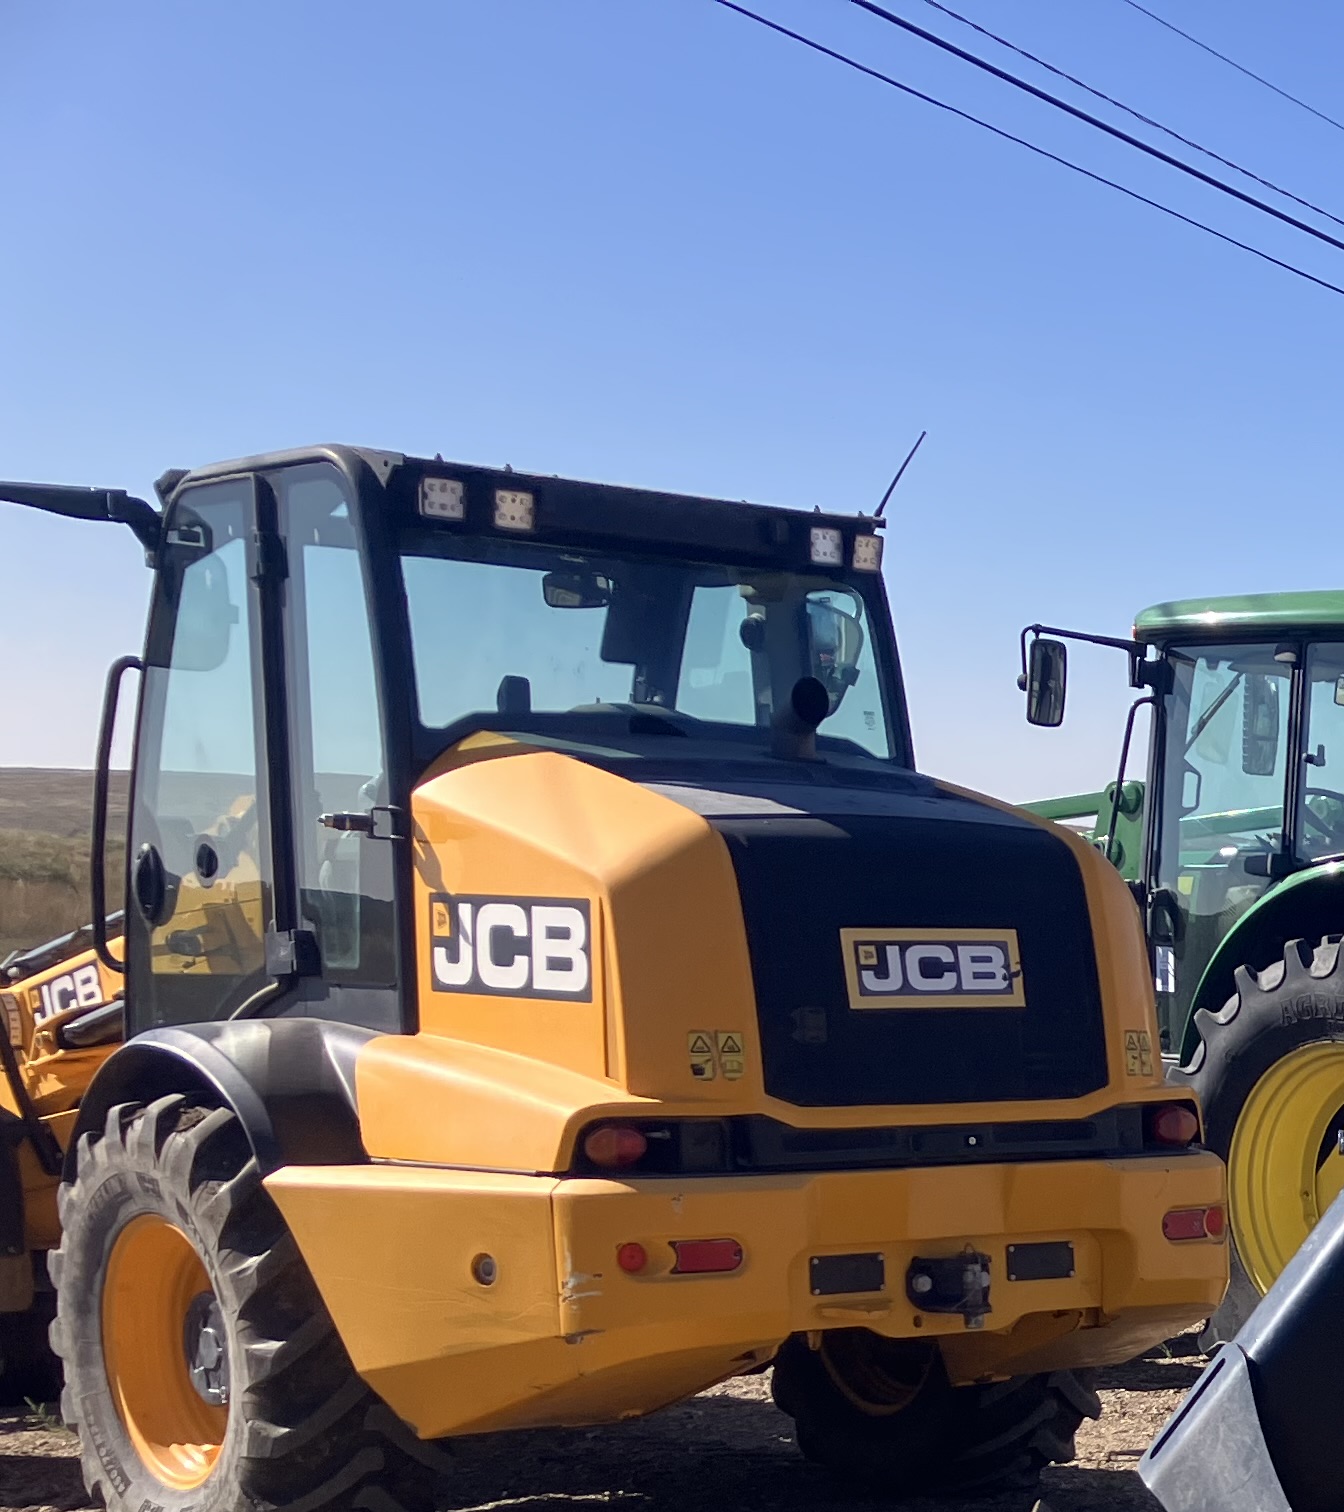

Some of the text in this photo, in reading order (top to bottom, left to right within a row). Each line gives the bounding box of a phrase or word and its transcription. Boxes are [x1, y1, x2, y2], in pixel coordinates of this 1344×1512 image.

[433, 903, 588, 992] JCB
[861, 944, 1010, 991] JCB
[34, 964, 103, 1027] JCB
